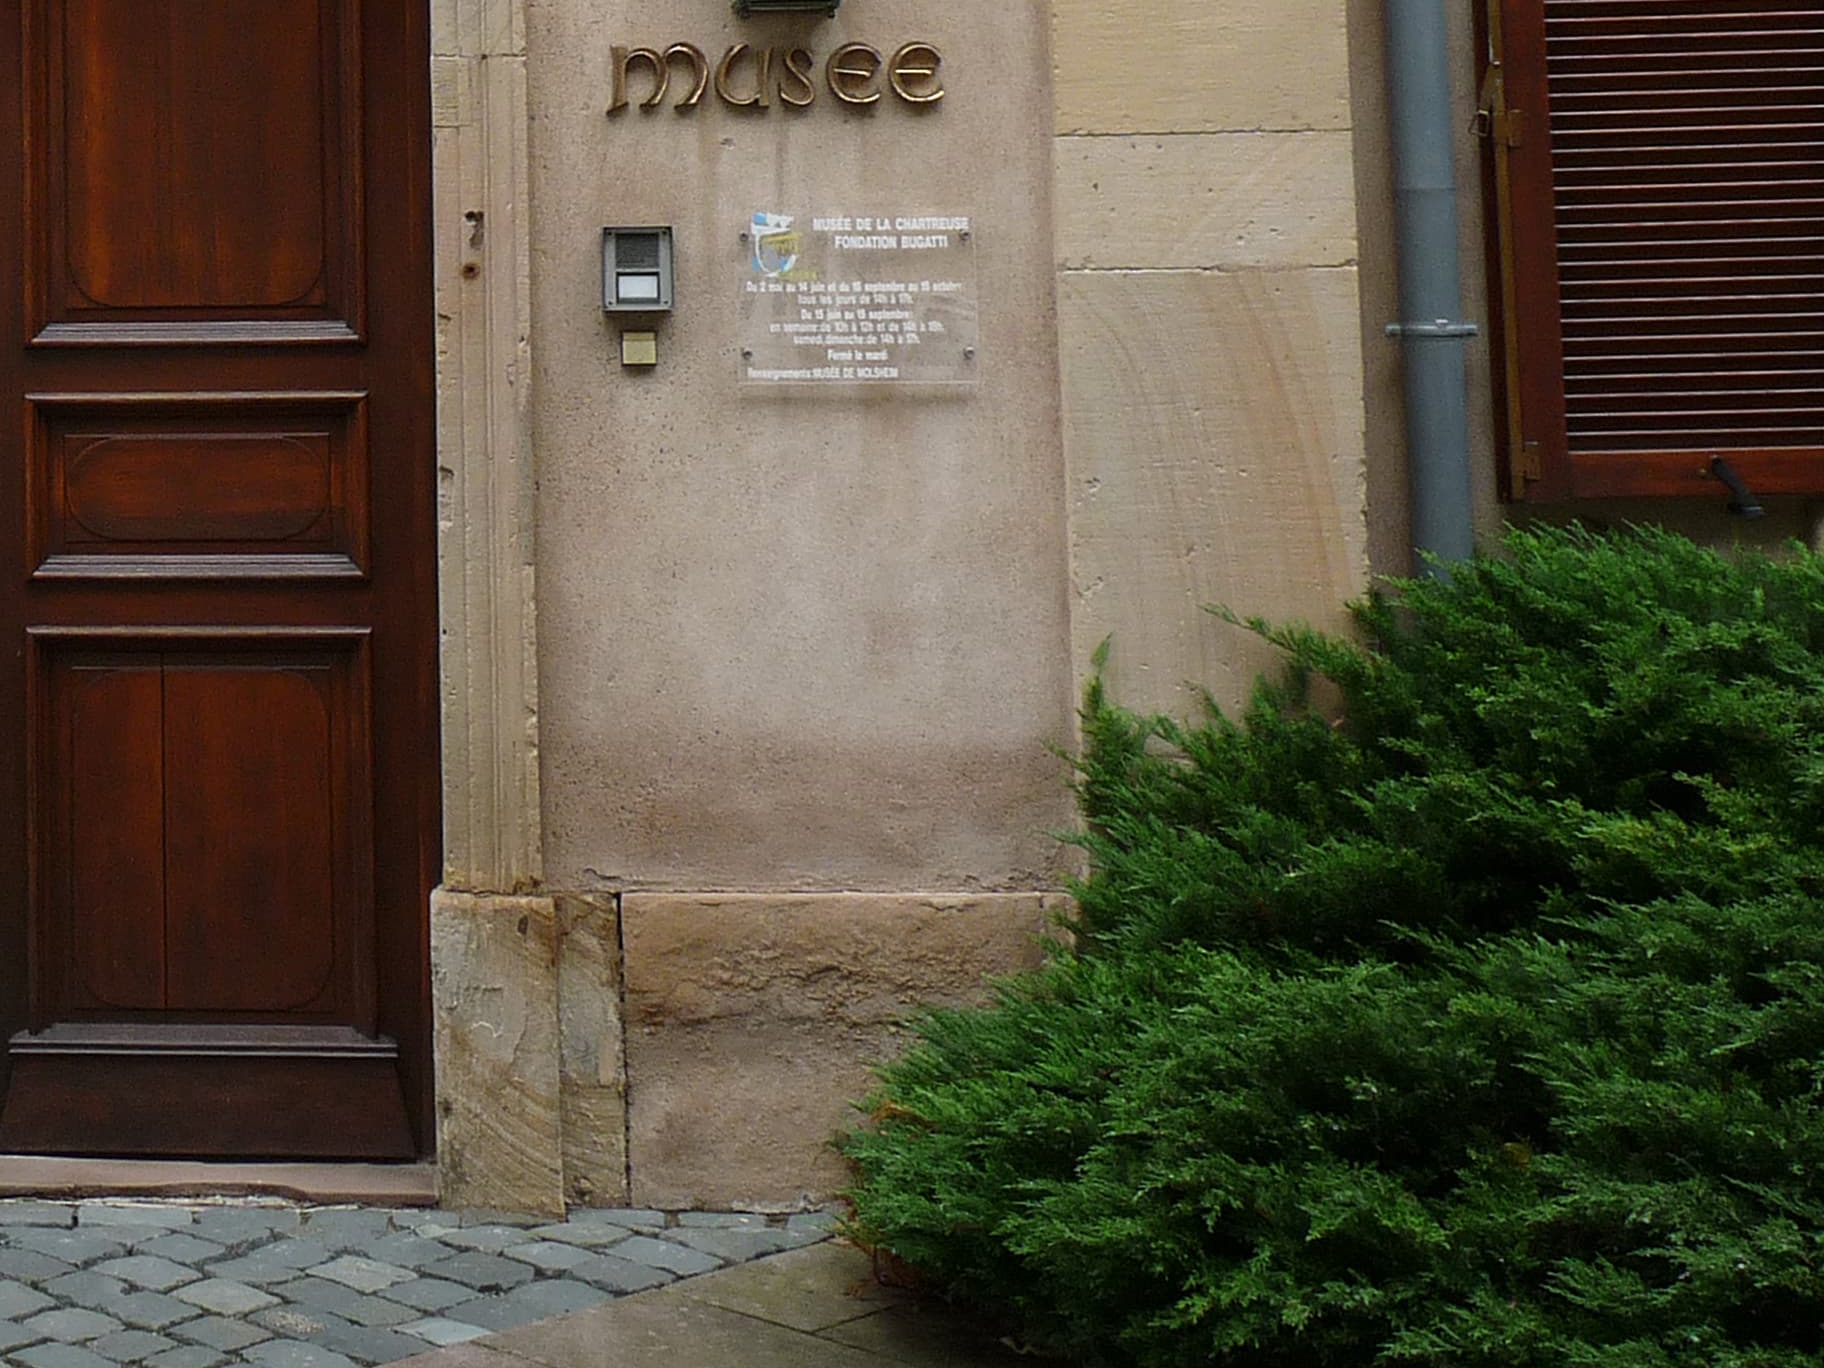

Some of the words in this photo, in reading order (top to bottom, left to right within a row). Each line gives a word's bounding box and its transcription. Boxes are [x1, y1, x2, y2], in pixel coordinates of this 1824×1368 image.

[812, 216, 852, 231] MUSÉE
[856, 217, 873, 231] DE
[876, 217, 892, 231] LA
[895, 216, 969, 230] CHARTREUSE
[834, 235, 897, 249] FONDATION
[901, 235, 948, 248] BUGATTI
[843, 367, 855, 379] DE
